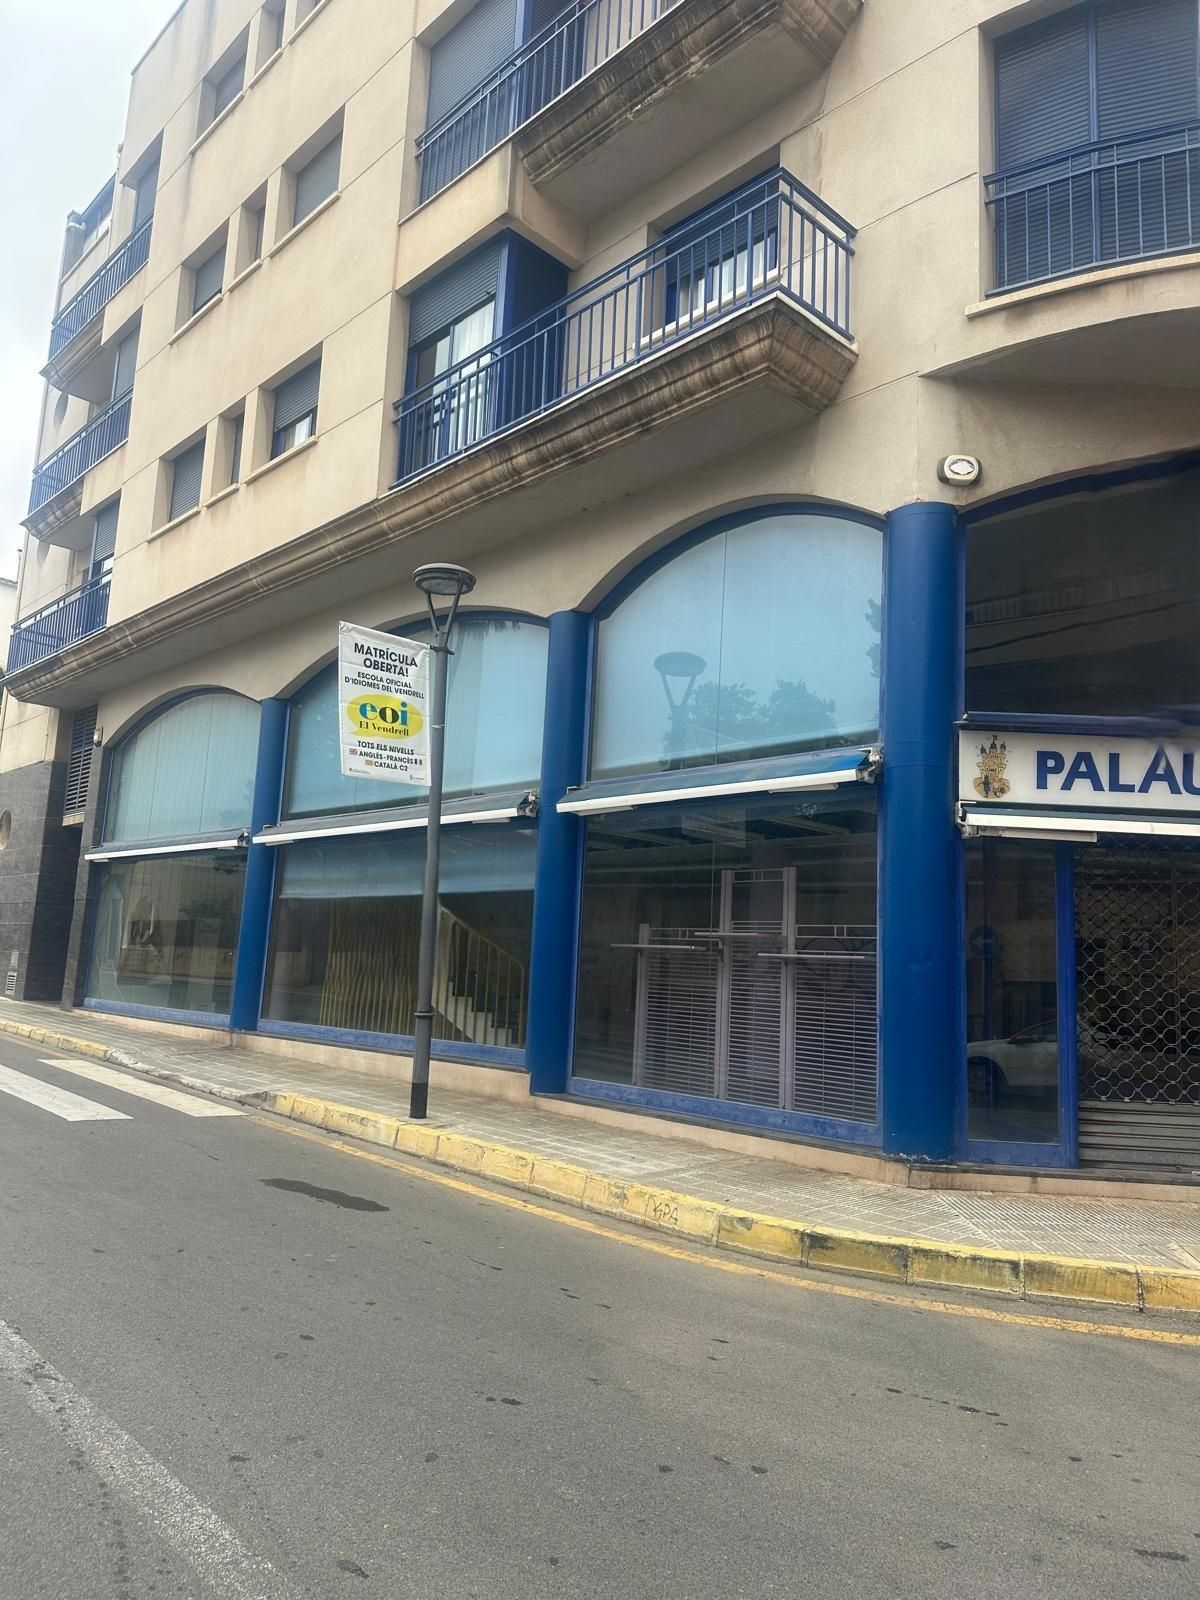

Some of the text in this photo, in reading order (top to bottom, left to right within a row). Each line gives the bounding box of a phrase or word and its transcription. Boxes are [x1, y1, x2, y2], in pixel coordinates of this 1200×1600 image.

[354, 642, 418, 667] MATRÍCULA
[363, 657, 409, 677] OBERTA!
[344, 676, 425, 699] D'IDIOMES DEL VENDRELL
[357, 671, 412, 689] ESCOLA OFICIAL
[359, 701, 408, 727] eoi
[359, 720, 409, 736] El Vendrell
[357, 740, 415, 755] TOTS ELS NIVELLS
